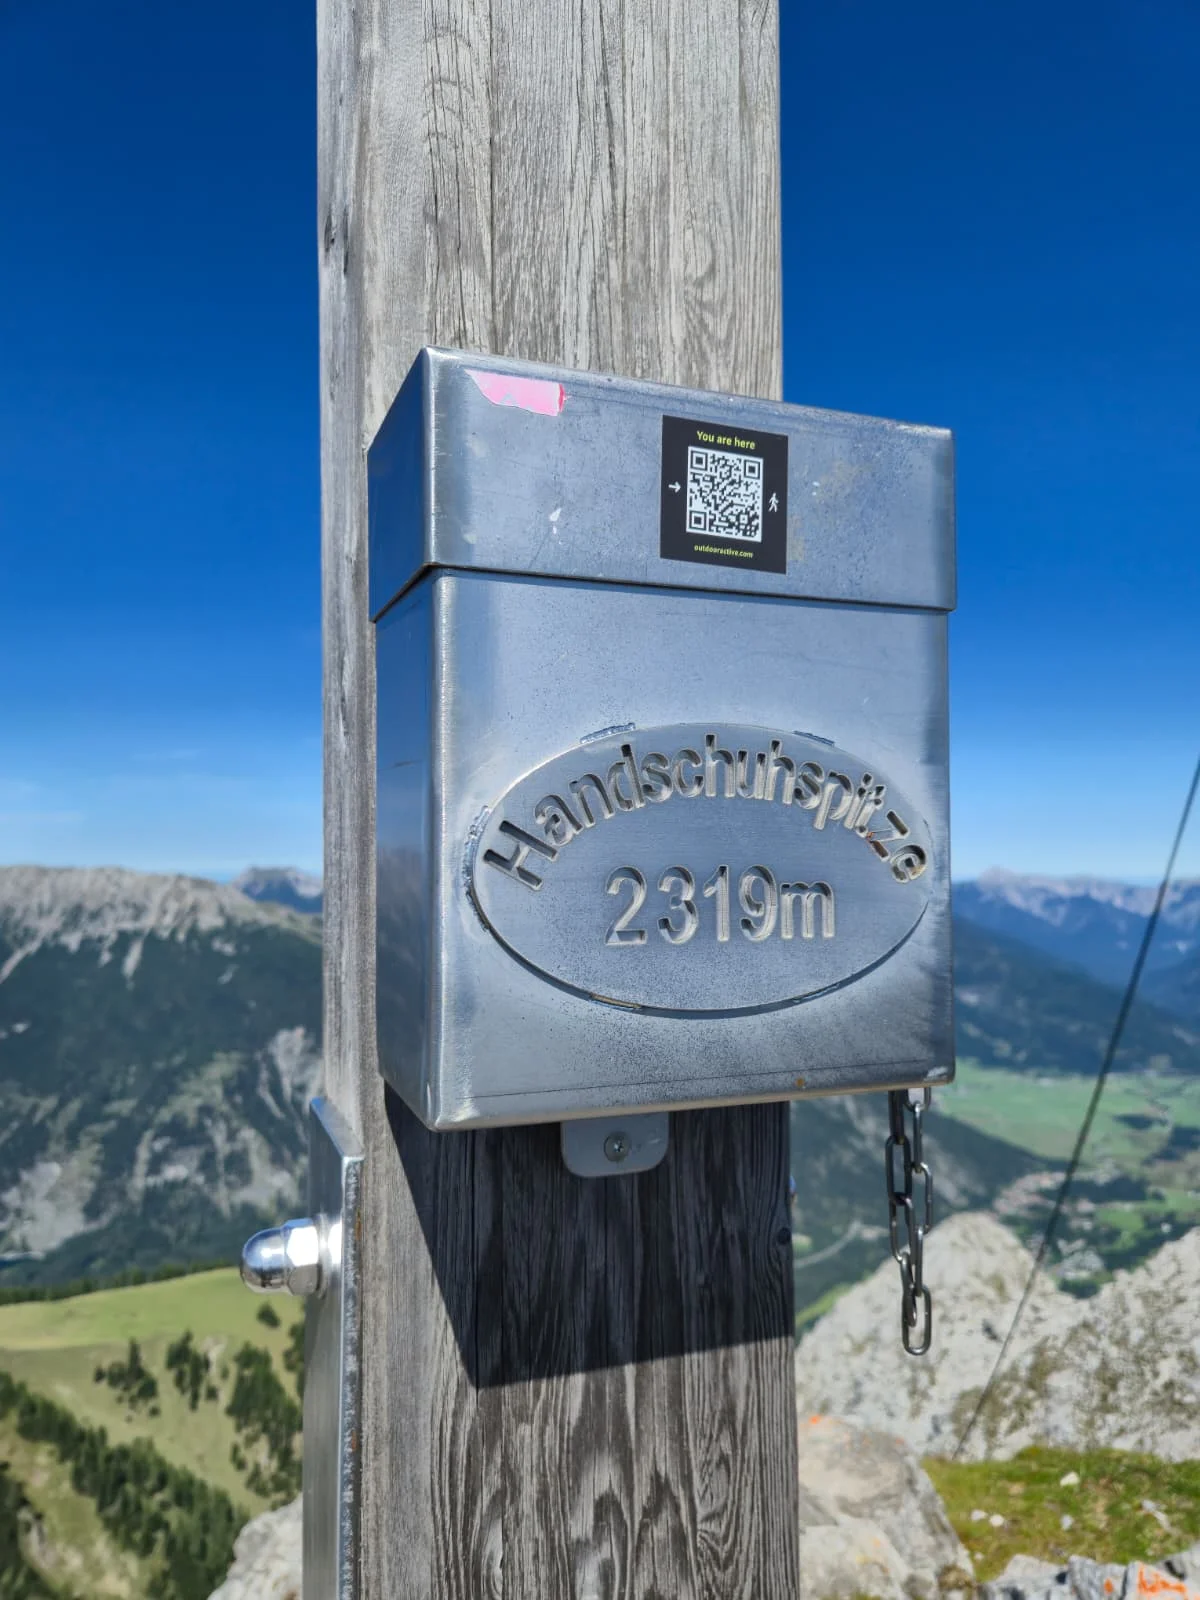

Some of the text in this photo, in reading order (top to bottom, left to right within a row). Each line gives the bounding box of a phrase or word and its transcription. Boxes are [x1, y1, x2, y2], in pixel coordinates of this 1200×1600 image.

[696, 431, 756, 450] You are here
[694, 544, 753, 558] outdooractive.com
[484, 733, 928, 891] Handschuhspitze
[605, 865, 835, 945] 2319m
